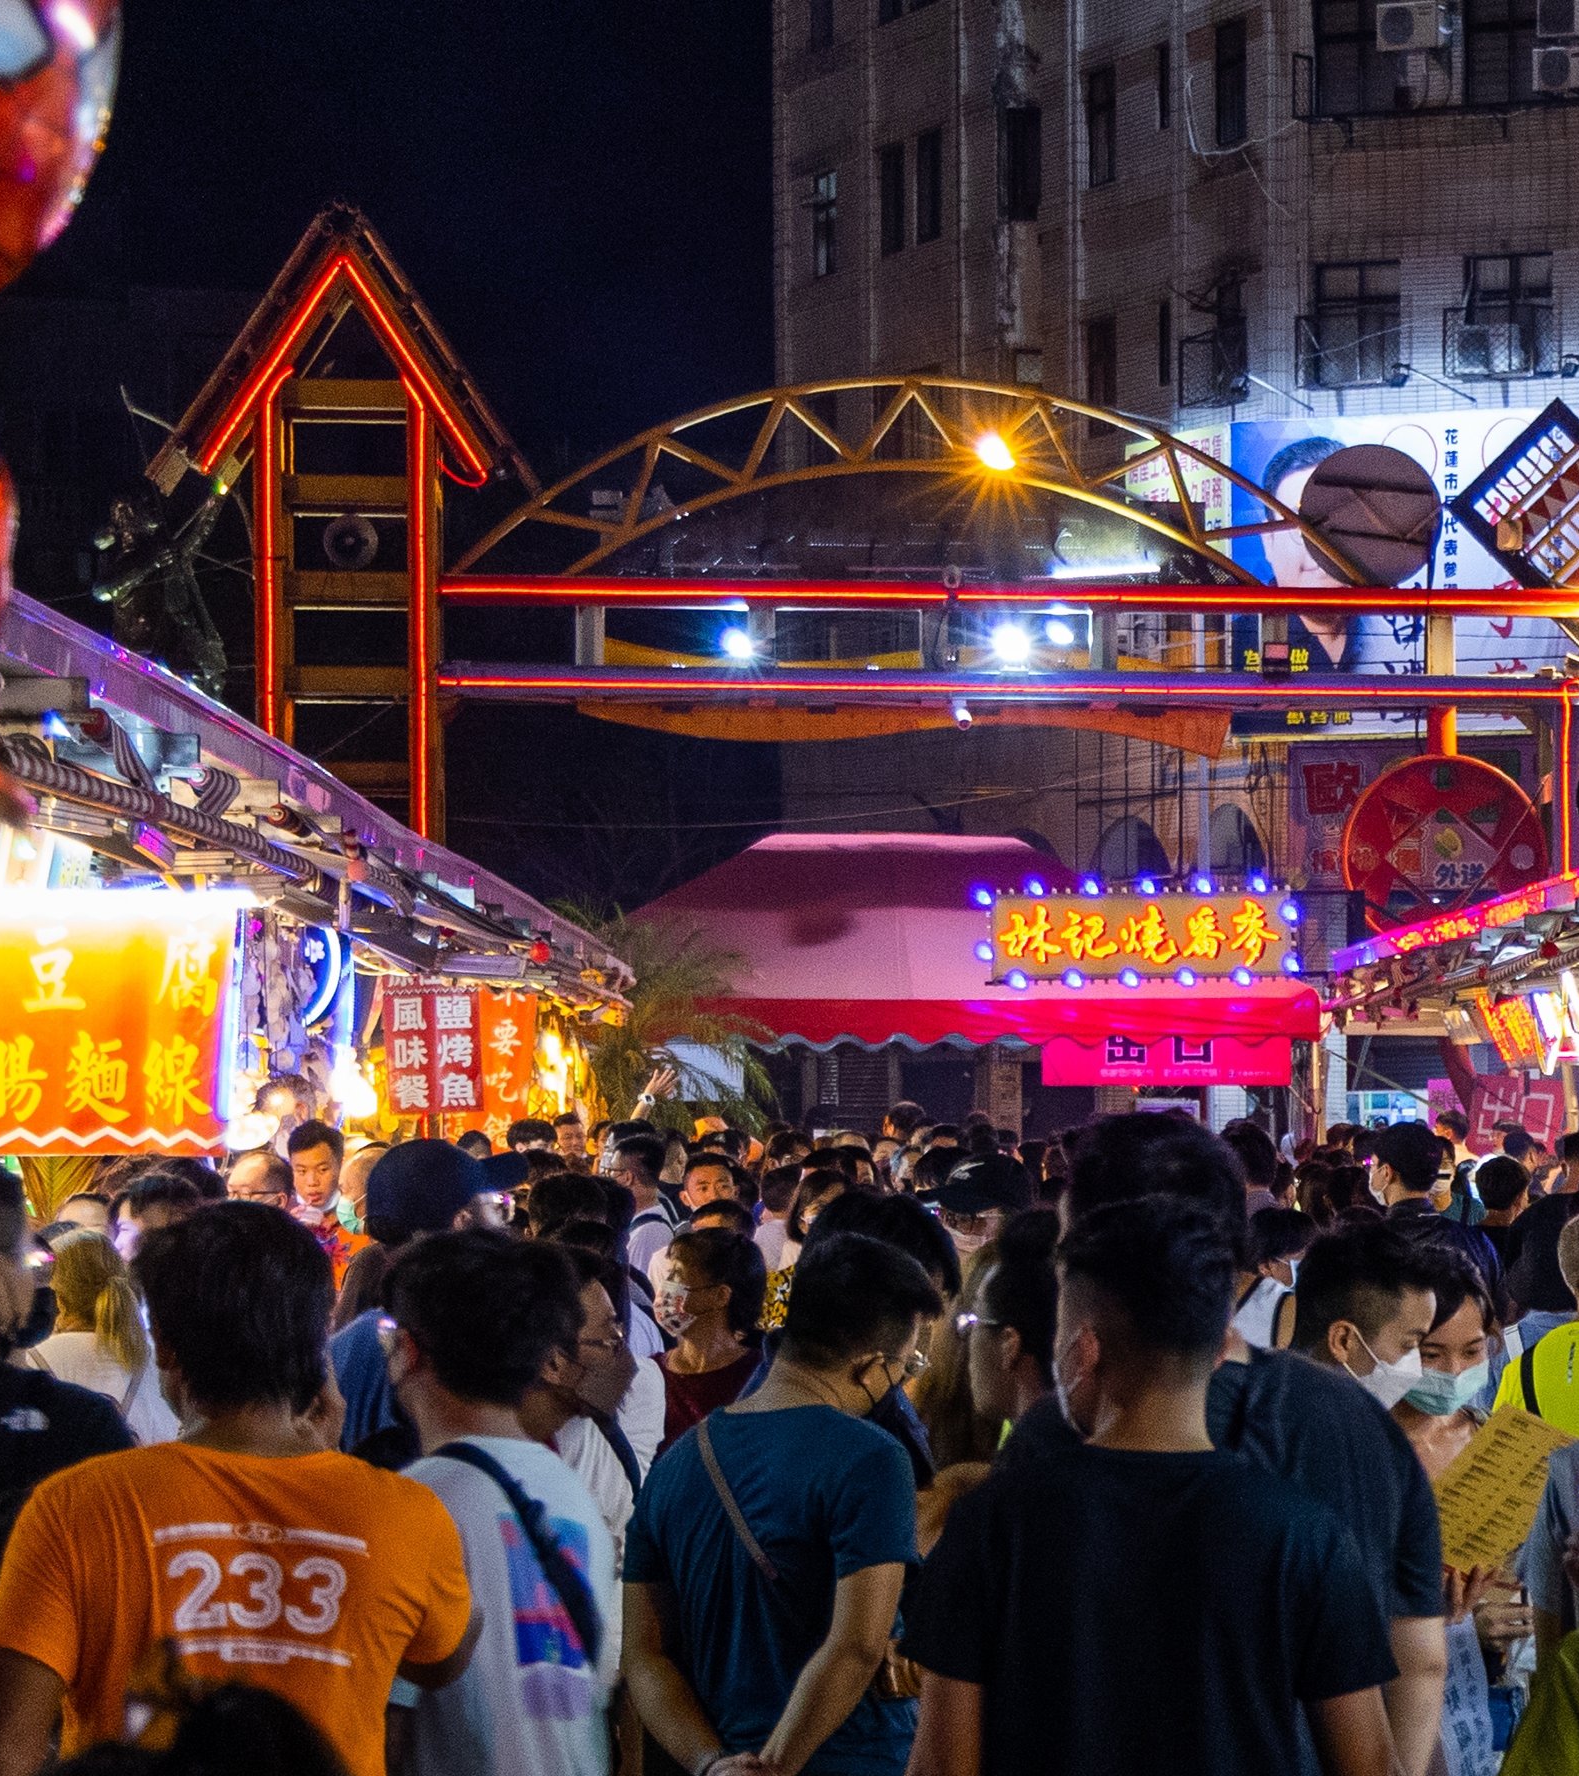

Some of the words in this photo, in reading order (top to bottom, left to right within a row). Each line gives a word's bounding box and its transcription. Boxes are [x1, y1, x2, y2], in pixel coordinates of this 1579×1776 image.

[1443, 428, 1460, 589] 花蓮市代表參
[998, 898, 1281, 968] 林記燒番麥
[392, 996, 430, 1110] 風味餐
[435, 994, 477, 1107] 鹽烤魚
[166, 1548, 348, 1636] 233
